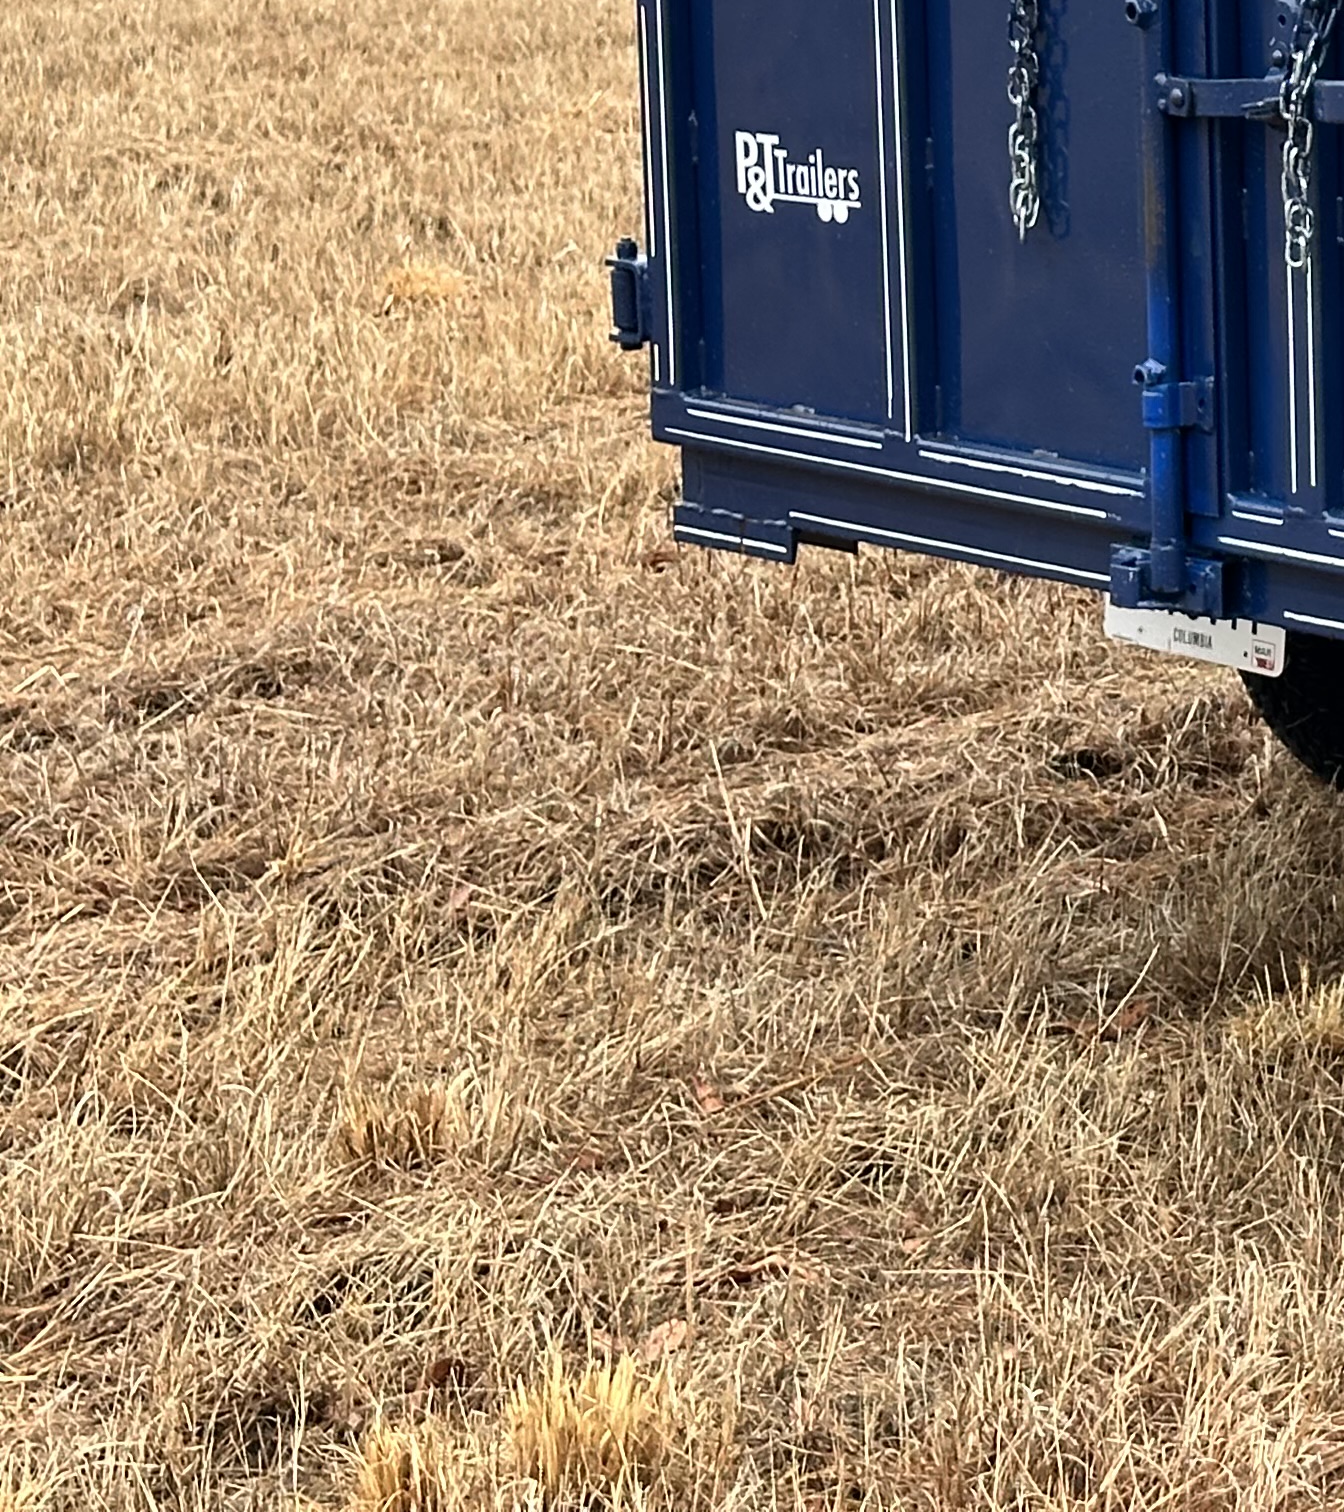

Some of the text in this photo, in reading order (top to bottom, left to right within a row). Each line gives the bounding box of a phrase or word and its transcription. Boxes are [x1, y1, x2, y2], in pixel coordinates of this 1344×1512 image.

[735, 130, 860, 214] P&T Trailers
[1173, 626, 1213, 650] COLUMBIA
